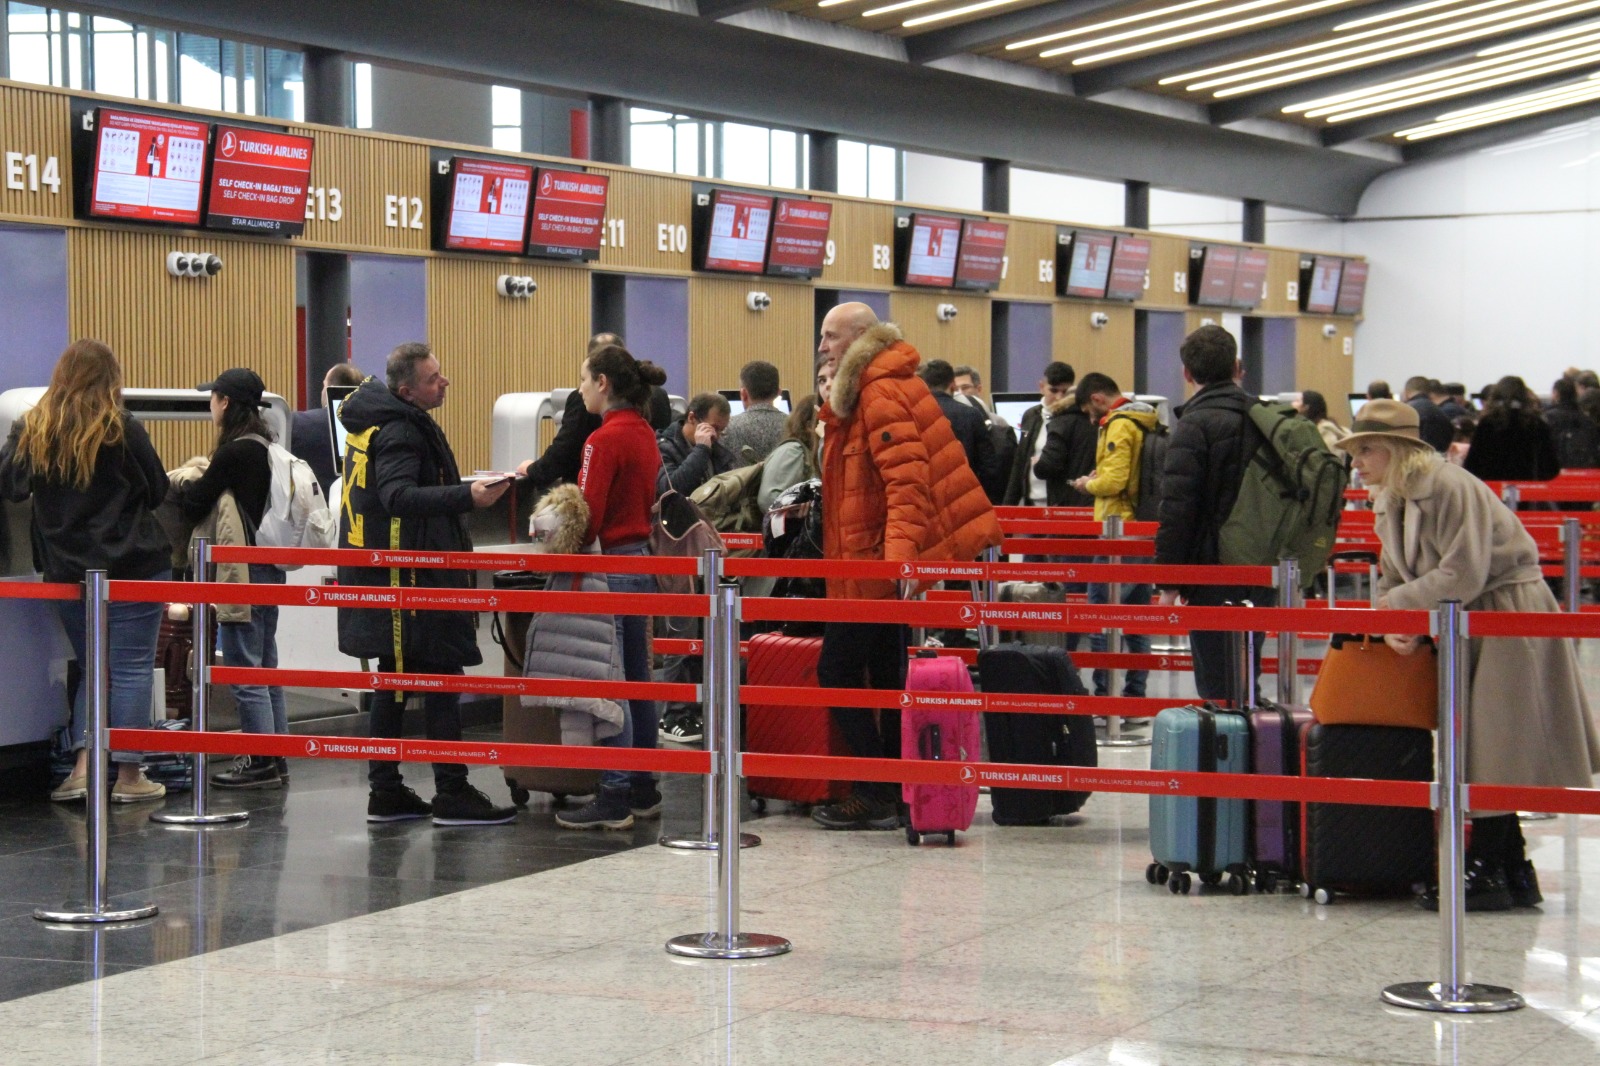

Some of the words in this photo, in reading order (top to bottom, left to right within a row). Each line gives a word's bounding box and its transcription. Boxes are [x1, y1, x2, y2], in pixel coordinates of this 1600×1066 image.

[239, 140, 273, 156] TURKISH
[274, 145, 308, 160] AIRLINES
[6, 151, 60, 193] E14
[218, 178, 233, 187] SELF
[234, 180, 262, 190] CHECK-IN
[263, 183, 281, 192] BAGAJ
[554, 180, 579, 192] TURKISH
[579, 183, 604, 195] AIRLINES
[223, 189, 237, 199] SELF
[238, 191, 265, 202] CHECK-IN
[266, 194, 278, 203] BAG
[279, 195, 295, 205] DROP
[304, 186, 342, 222] E13
[385, 194, 423, 230] E12
[232, 217, 247, 226] STAR
[247, 219, 274, 229] ALLIANCE
[657, 223, 687, 253] E10
[873, 244, 890, 270] E8
[1039, 259, 1053, 283] E6
[385, 555, 414, 563] TURKISH
[414, 556, 444, 564] AIRLINES
[917, 566, 948, 575] TURKISH
[950, 567, 983, 575] AIRLINES
[323, 592, 359, 601] TURKISH
[360, 593, 396, 602] AIRLINES
[980, 610, 1019, 619] TURKISH
[1022, 610, 1062, 620] AIRLINES
[384, 678, 413, 686] TURKISH
[414, 679, 443, 687] AIRLINES
[915, 697, 948, 705] TURKISH
[949, 698, 982, 706] AIRLINES
[323, 744, 359, 753] TURKISH
[360, 745, 397, 755] AIRLINES
[980, 771, 1020, 781] TURKISH
[1022, 773, 1063, 783] AIRLINES
